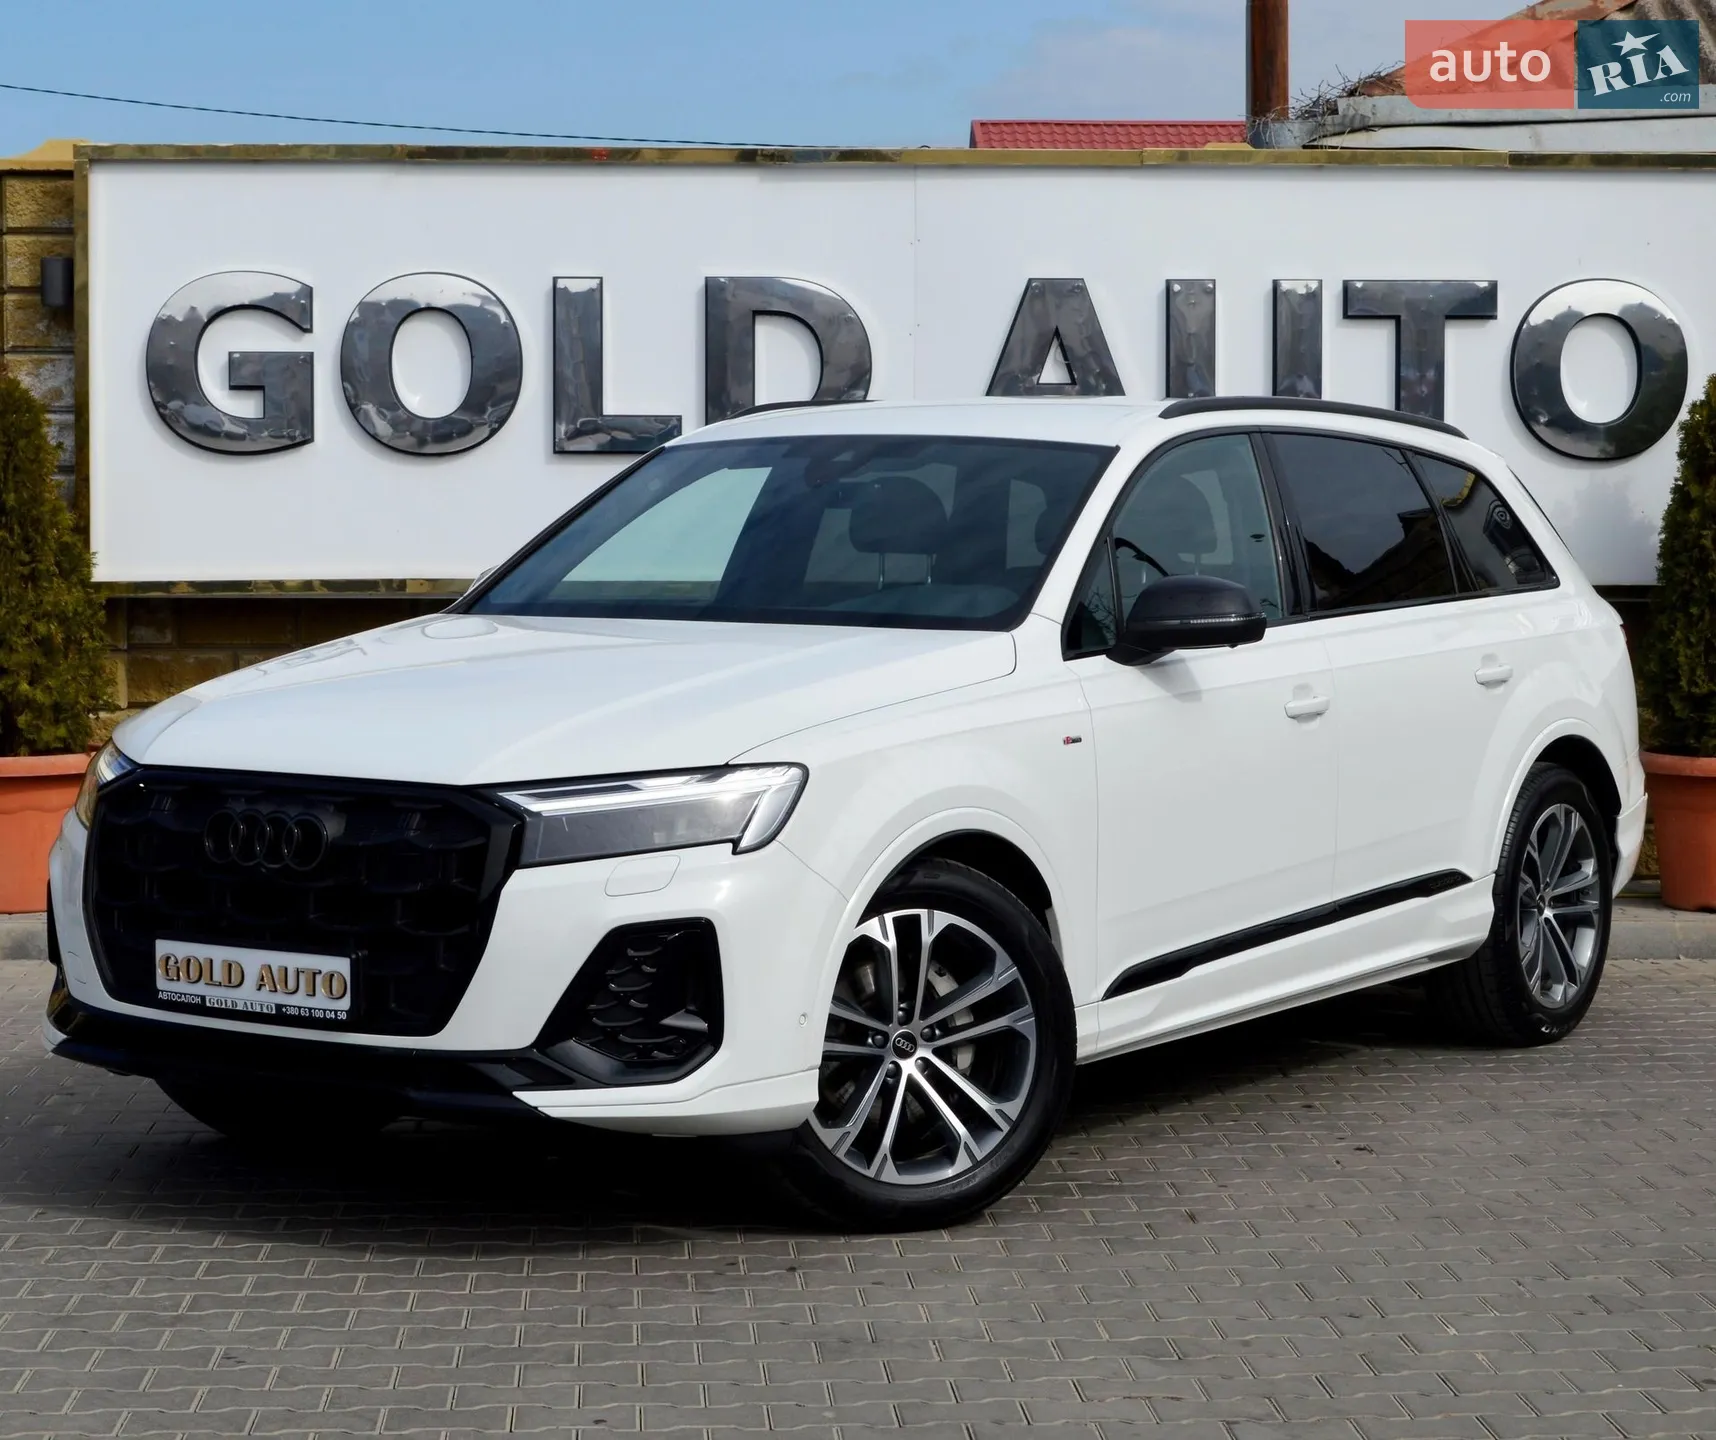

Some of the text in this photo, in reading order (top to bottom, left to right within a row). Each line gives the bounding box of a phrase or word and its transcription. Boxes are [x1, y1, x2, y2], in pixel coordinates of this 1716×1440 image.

[146, 271, 1689, 461] GOLD AUTO
[158, 953, 348, 999] GOLD AUTO
[158, 991, 347, 1020] АВТОСАЛОН GOLD AUTO +380 63 100 04 50
